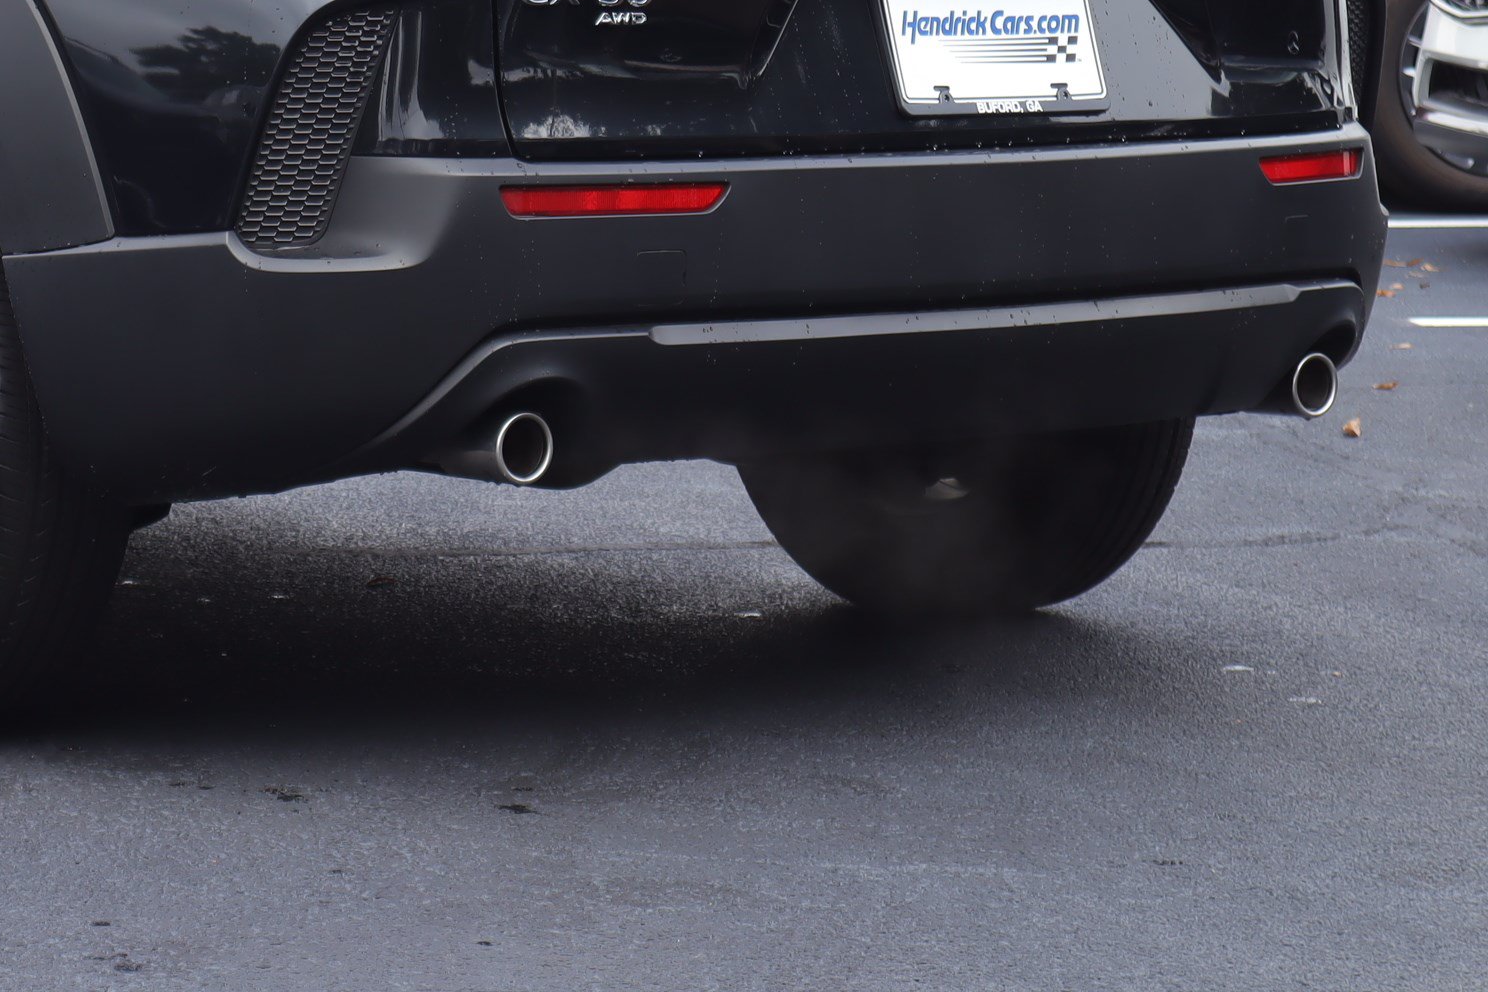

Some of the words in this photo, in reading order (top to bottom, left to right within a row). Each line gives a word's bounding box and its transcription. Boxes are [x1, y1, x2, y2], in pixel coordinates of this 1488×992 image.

[595, 12, 647, 26] AWD
[976, 100, 1024, 114] BUFORD,
[1025, 99, 1043, 113] GA
